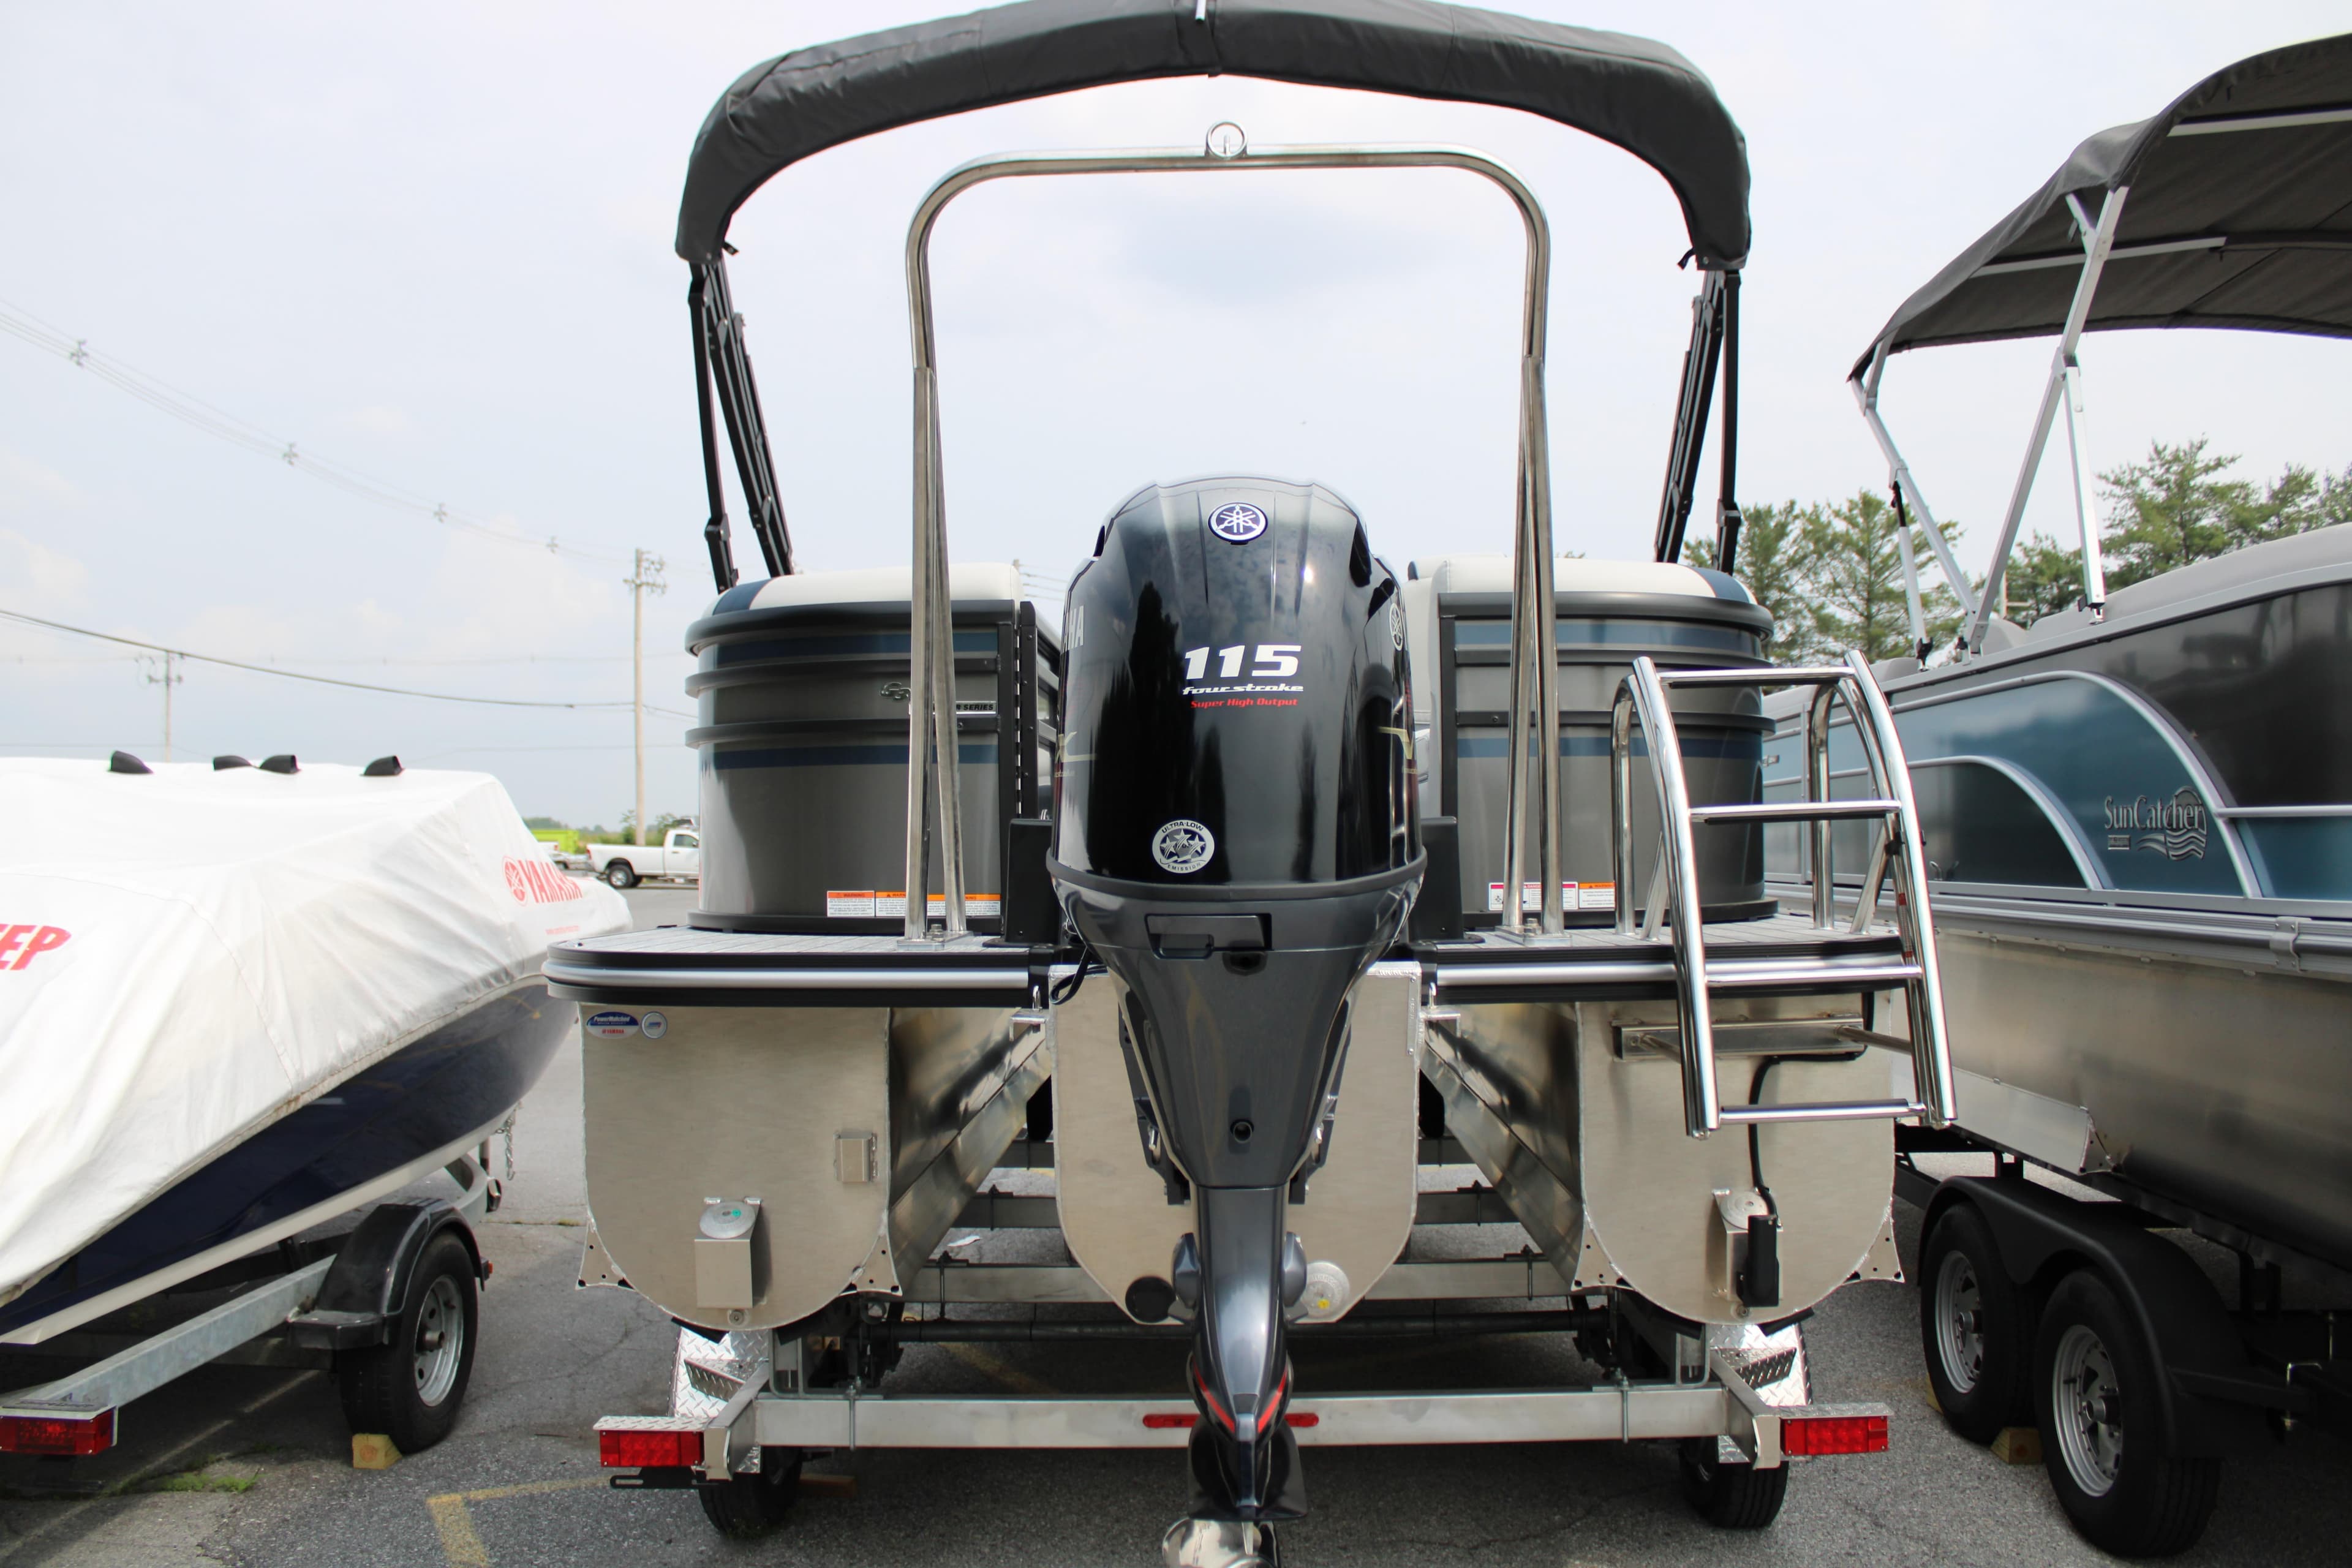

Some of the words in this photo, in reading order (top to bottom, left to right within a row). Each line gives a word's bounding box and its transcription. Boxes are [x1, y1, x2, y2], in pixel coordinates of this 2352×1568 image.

[1185, 645, 1302, 680] 115
[1182, 683, 1304, 695] fourstroke
[1191, 700, 1225, 709] Super
[1227, 698, 1254, 707] High
[1257, 698, 1298, 707] Output
[2105, 795, 2204, 830] SunCatcher
[1167, 862, 1201, 872] EMISSION
[517, 858, 583, 903] YAMAHA
